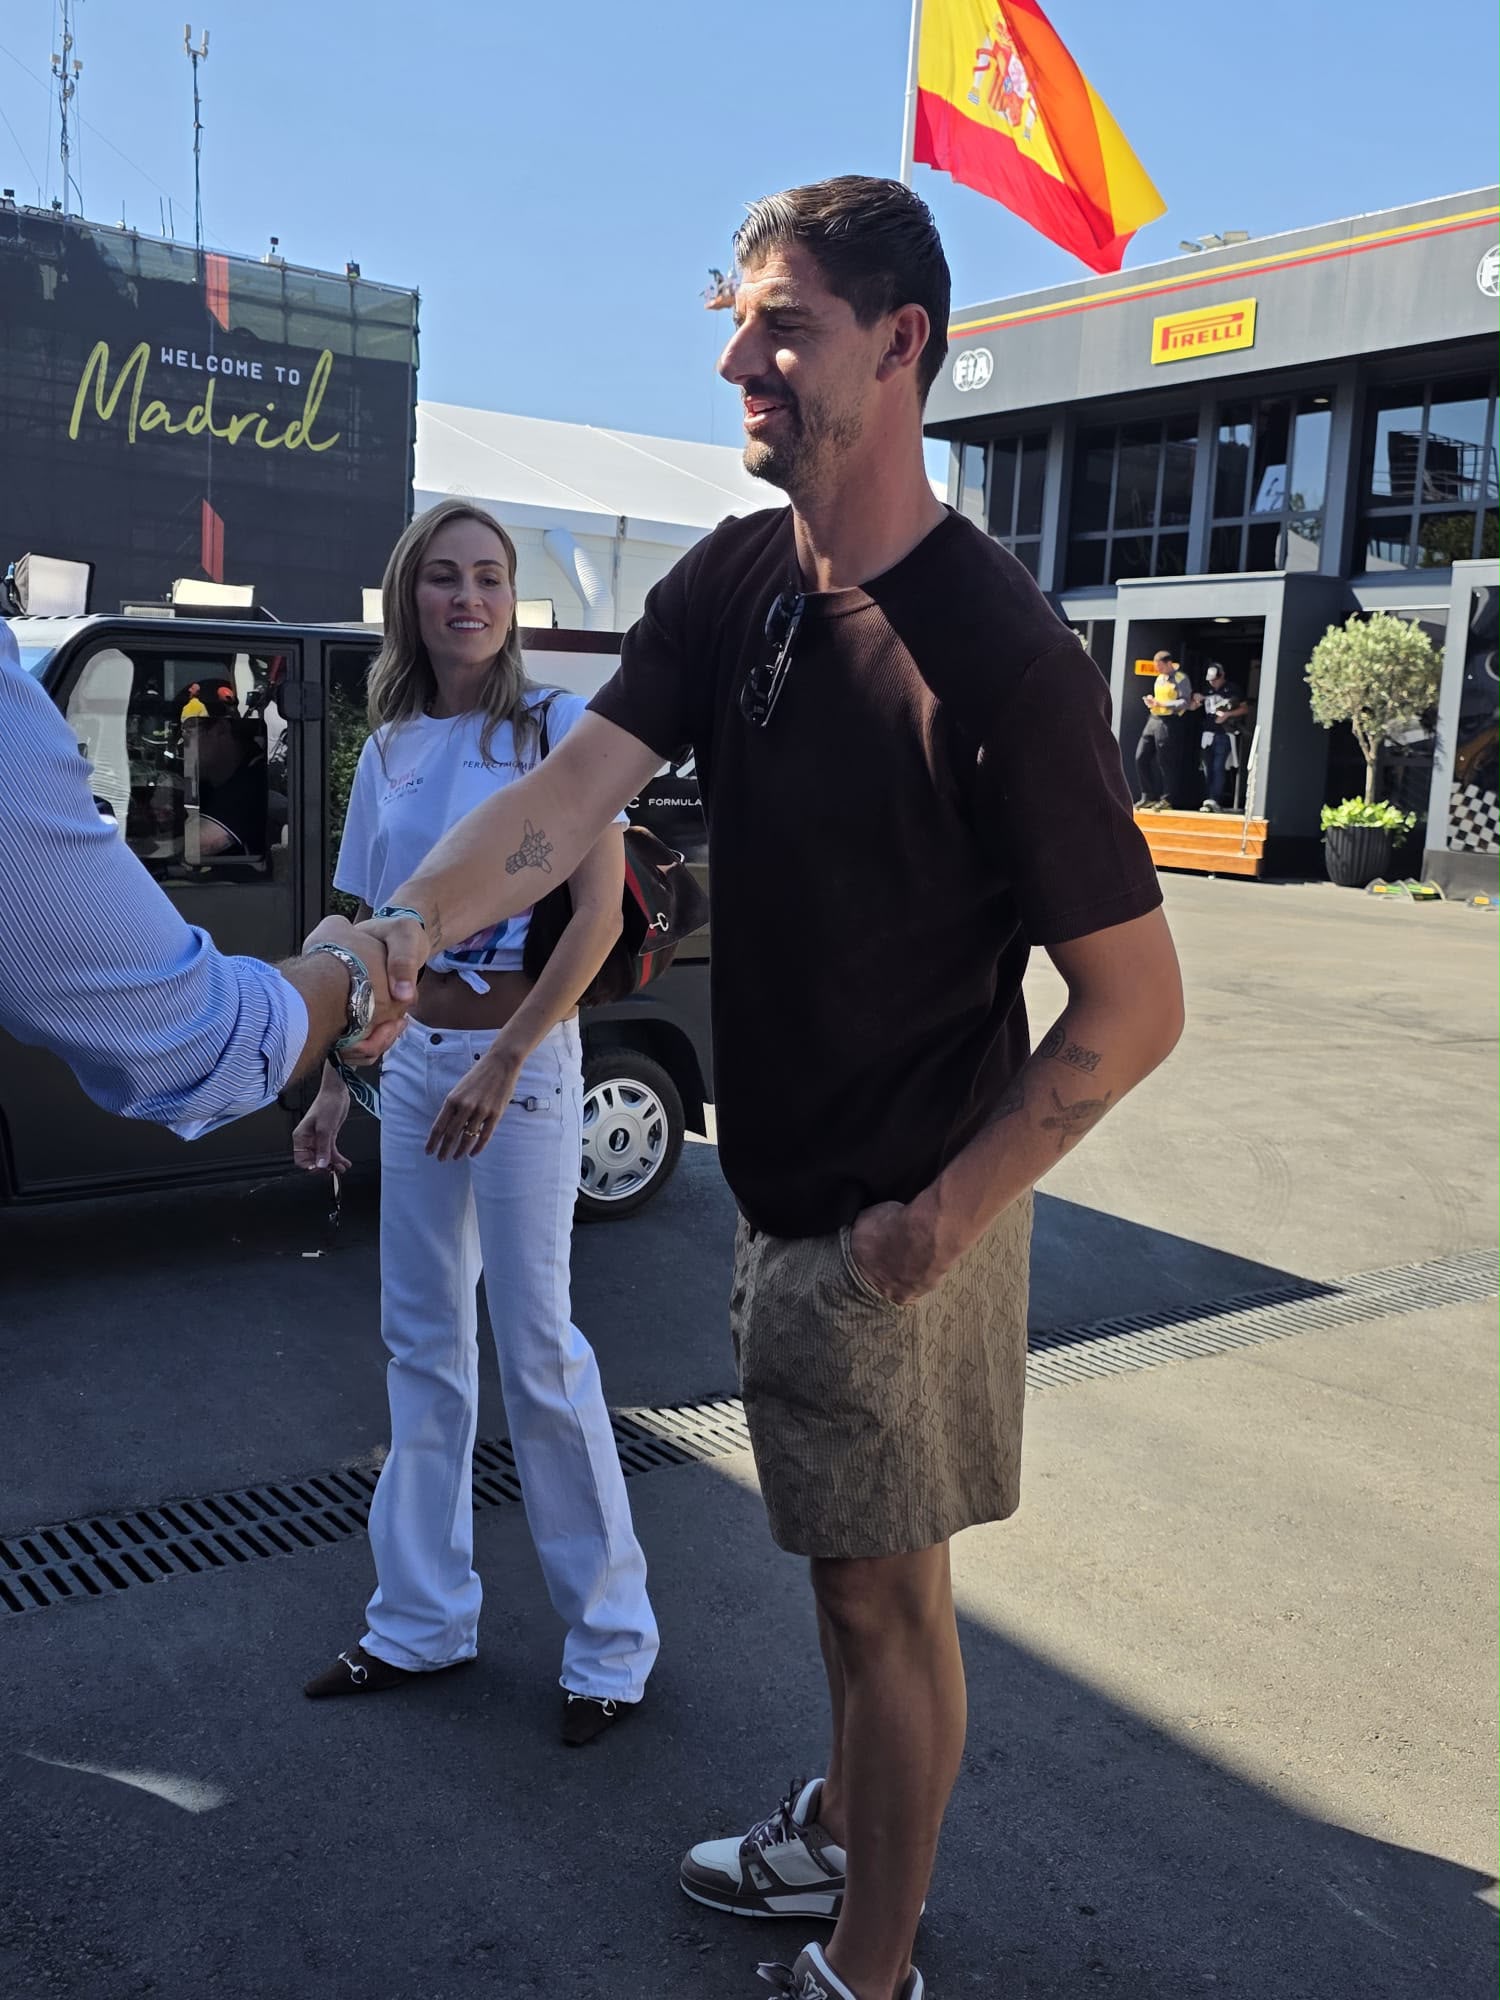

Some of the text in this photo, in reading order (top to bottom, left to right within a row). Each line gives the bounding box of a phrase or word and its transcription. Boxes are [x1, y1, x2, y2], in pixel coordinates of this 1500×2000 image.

[1161, 311, 1244, 351] PIRELLI
[161, 346, 300, 386] WELCOME TO
[955, 353, 990, 386] FIA
[68, 341, 340, 451] Madrid
[648, 798, 702, 806] FORMULA
